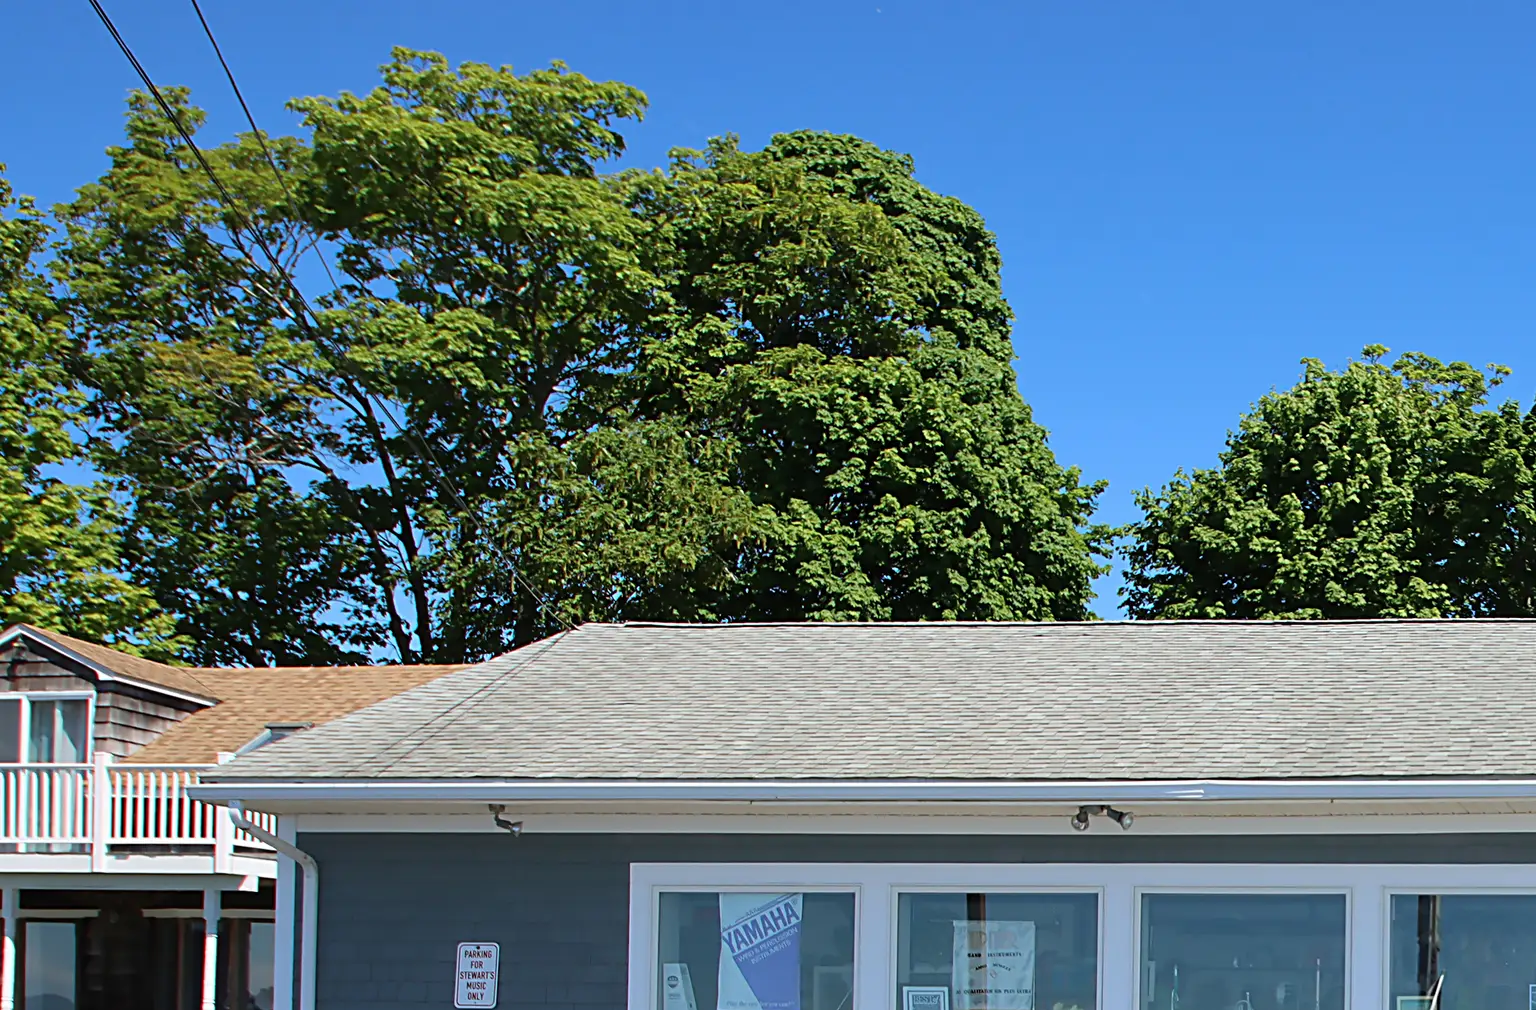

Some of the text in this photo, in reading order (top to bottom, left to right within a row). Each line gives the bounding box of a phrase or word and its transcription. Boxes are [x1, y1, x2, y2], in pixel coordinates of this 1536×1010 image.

[722, 901, 800, 953] YAMAHA
[464, 950, 492, 958] PARKING
[466, 982, 486, 990] MUSIC
[468, 992, 484, 1000] ONLY
